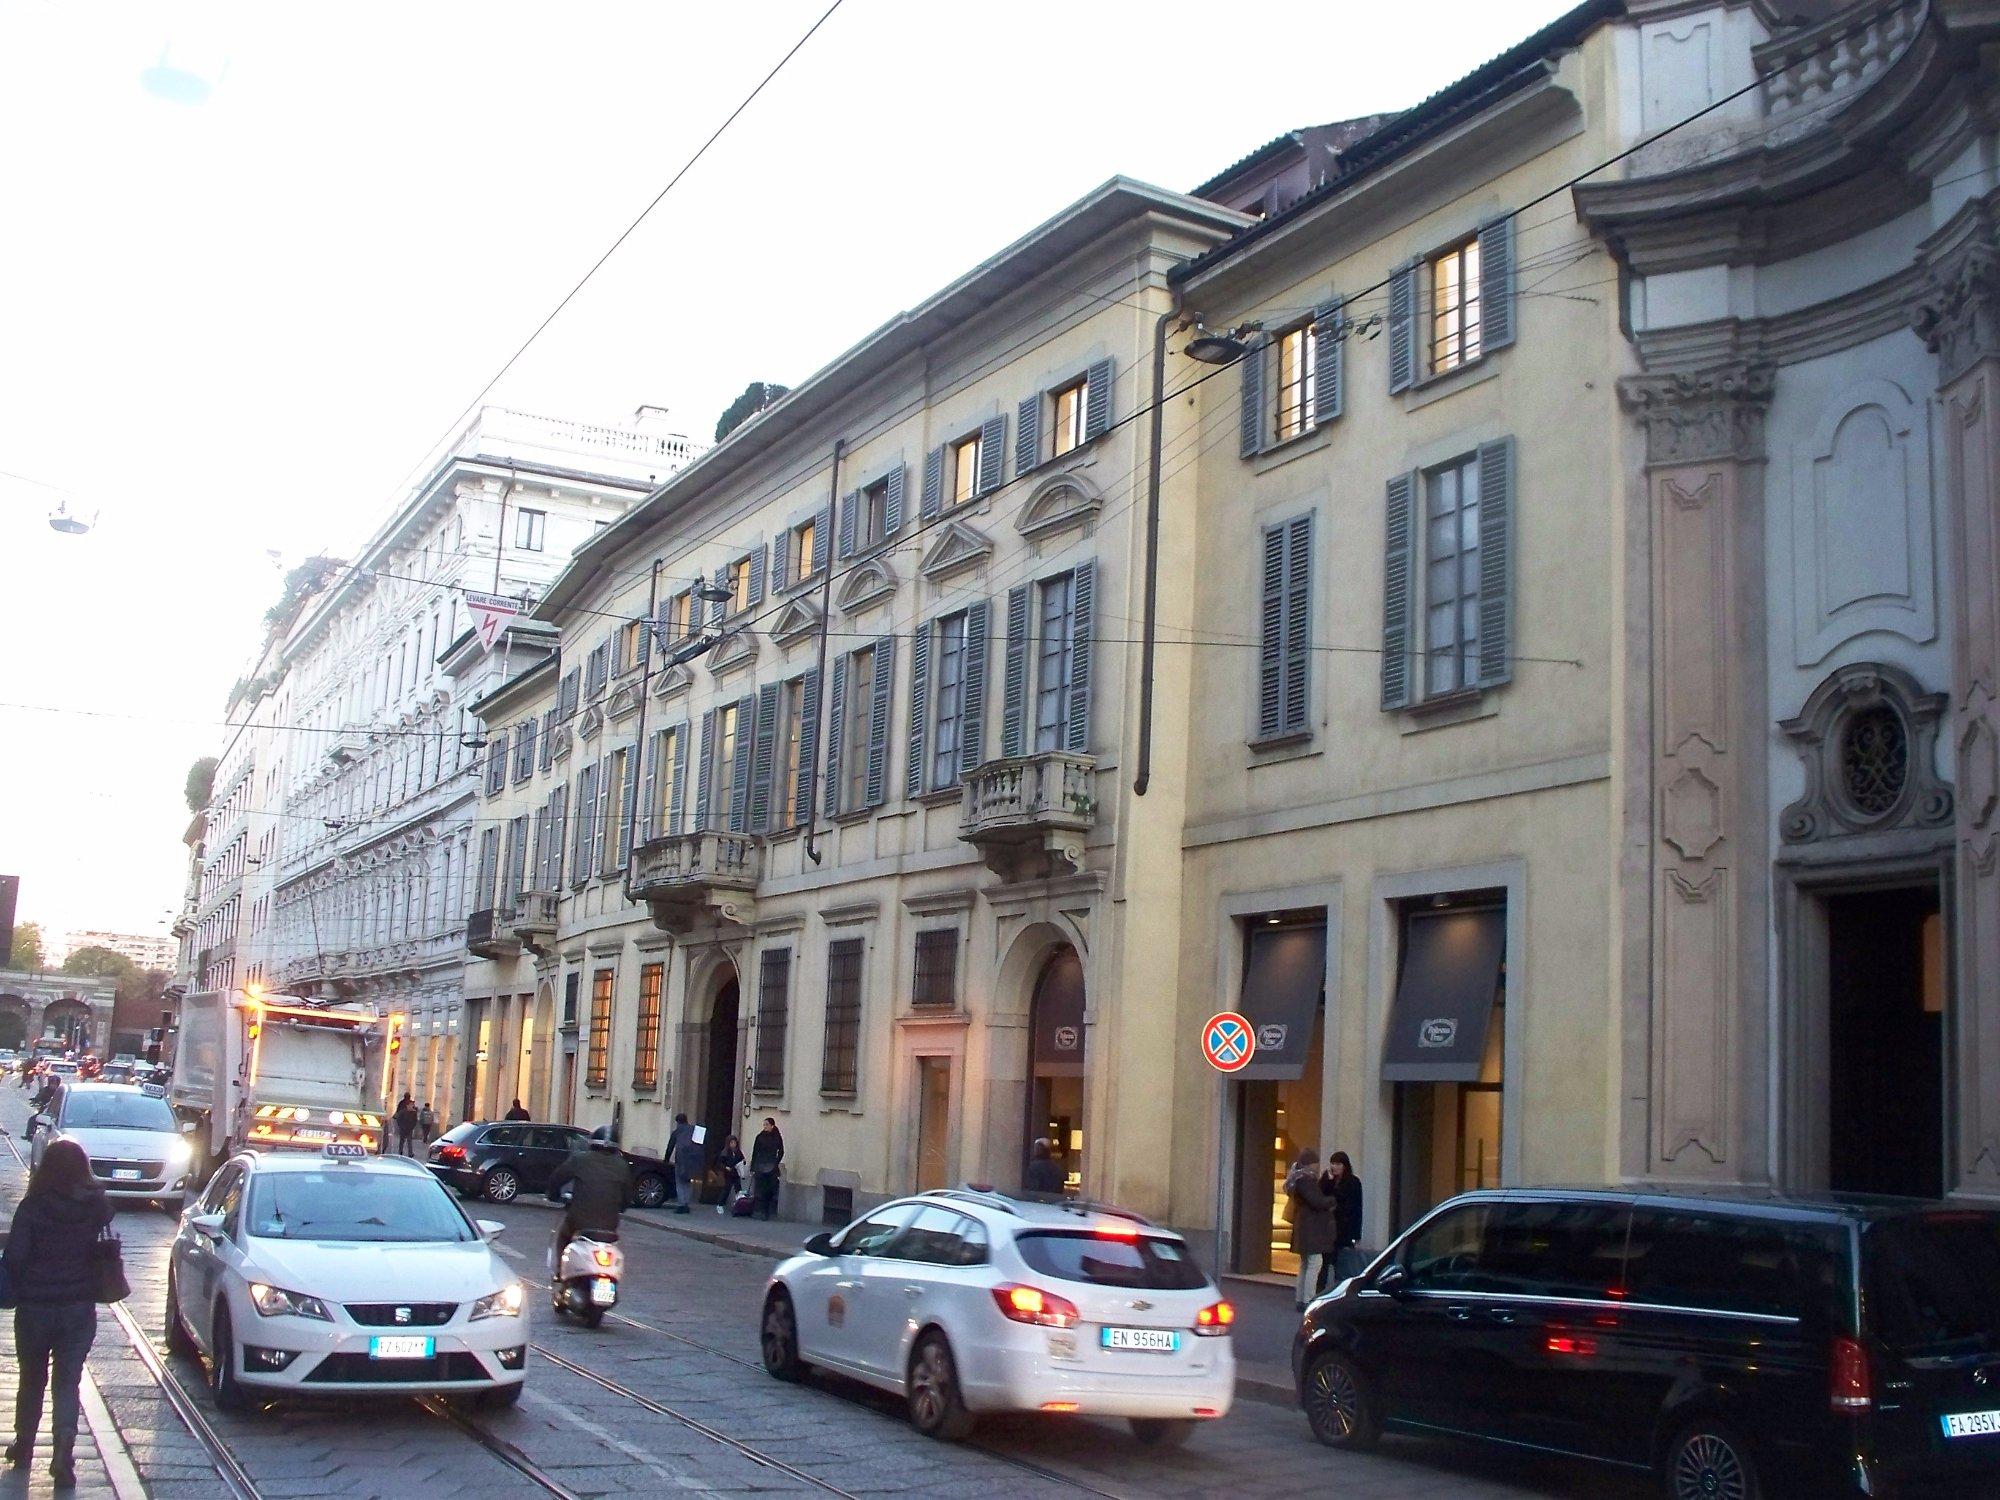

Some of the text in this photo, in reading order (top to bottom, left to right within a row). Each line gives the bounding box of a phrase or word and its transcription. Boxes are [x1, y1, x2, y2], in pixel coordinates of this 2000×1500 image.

[466, 594, 518, 610] LEVARE CORRENTE
[328, 1145, 362, 1155] TAXI
[1113, 1330, 1171, 1348] EN 956HA
[1950, 1416, 1966, 1434] FA
